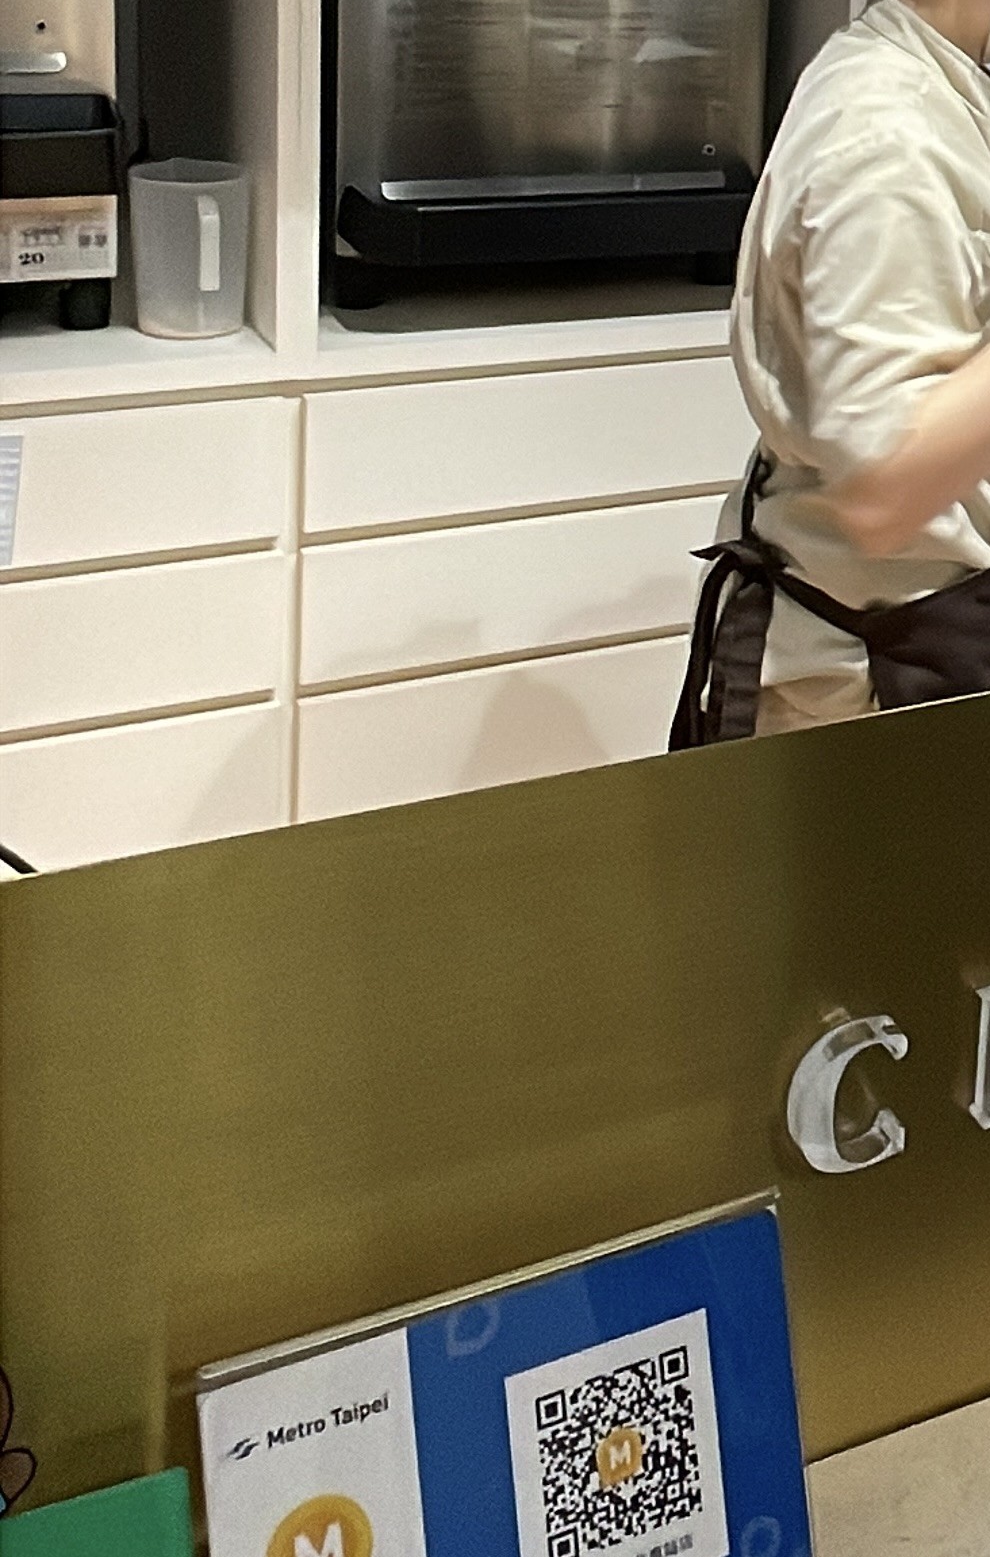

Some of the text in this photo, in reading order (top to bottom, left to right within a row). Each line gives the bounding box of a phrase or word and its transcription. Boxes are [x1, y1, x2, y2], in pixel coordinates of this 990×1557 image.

[18, 252, 44, 265] 20
[266, 1392, 390, 1449] Metro Taipei
